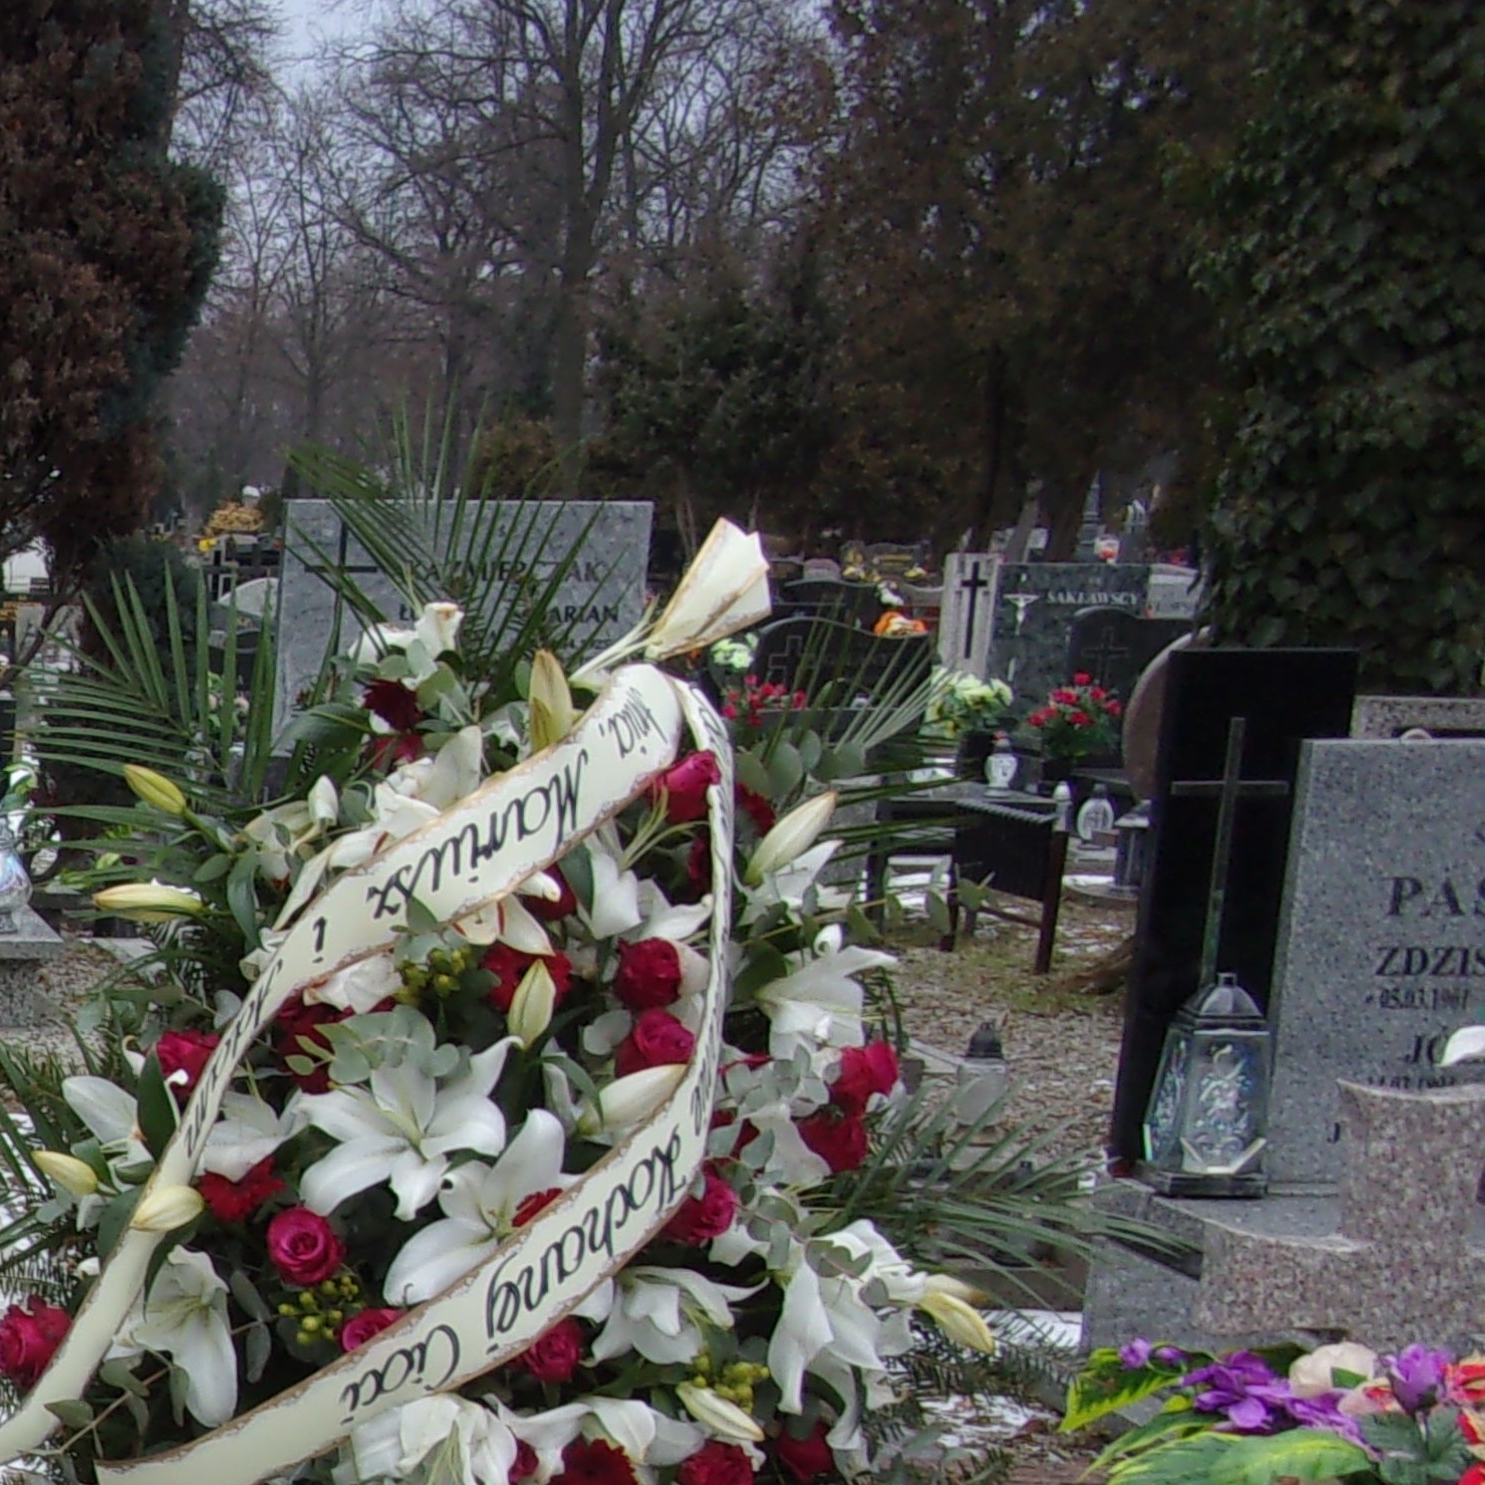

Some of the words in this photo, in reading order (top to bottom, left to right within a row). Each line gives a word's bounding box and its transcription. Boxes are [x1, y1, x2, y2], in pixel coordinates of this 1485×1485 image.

[542, 605, 618, 623] ARIAN
[366, 748, 590, 920] Mariusz
[312, 914, 327, 951] i
[485, 1127, 687, 1357] Kochanej
[339, 1324, 461, 1423] Cioci
